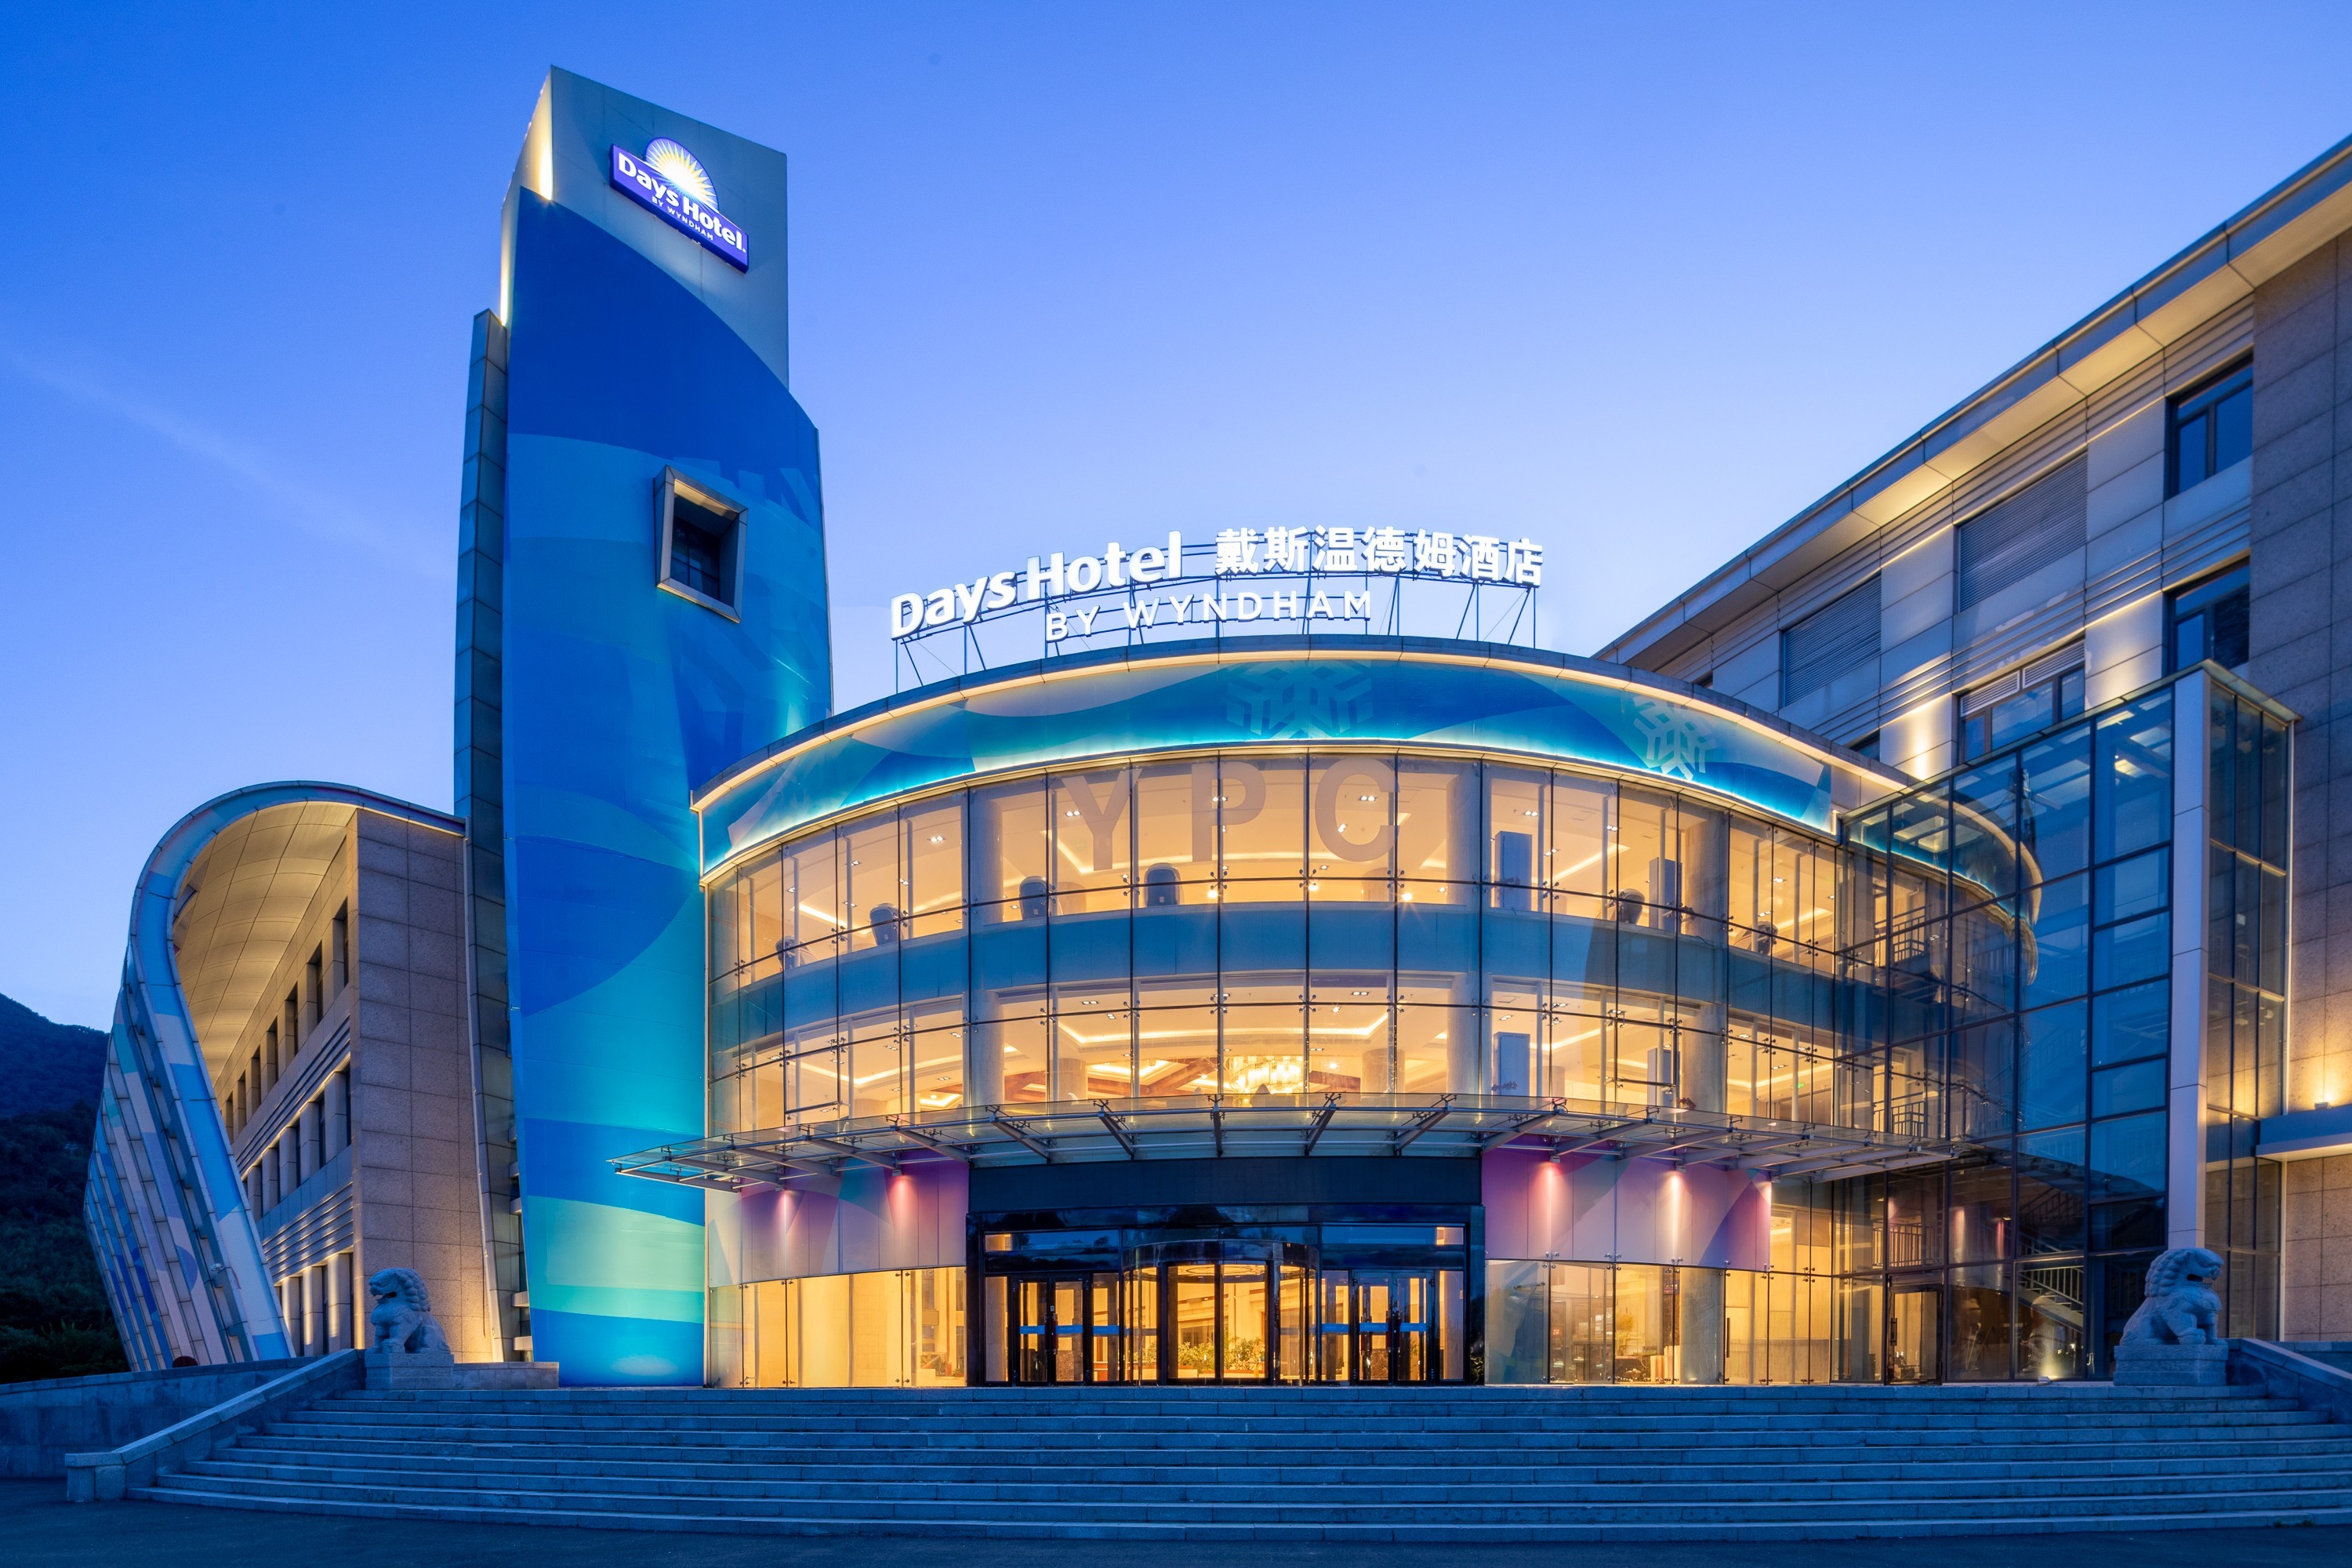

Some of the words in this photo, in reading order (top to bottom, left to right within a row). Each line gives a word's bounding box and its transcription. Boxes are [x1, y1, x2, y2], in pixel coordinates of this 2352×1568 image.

[619, 152, 679, 207] Days
[652, 196, 663, 208] BY
[667, 205, 713, 241] WYNDHAM
[1214, 524, 1544, 587] 戴斯温德姆酒店
[891, 571, 1017, 641] Days
[1027, 530, 1182, 601] Hotel
[1046, 605, 1101, 642] BY
[1123, 590, 1372, 630] WYNDHAM
